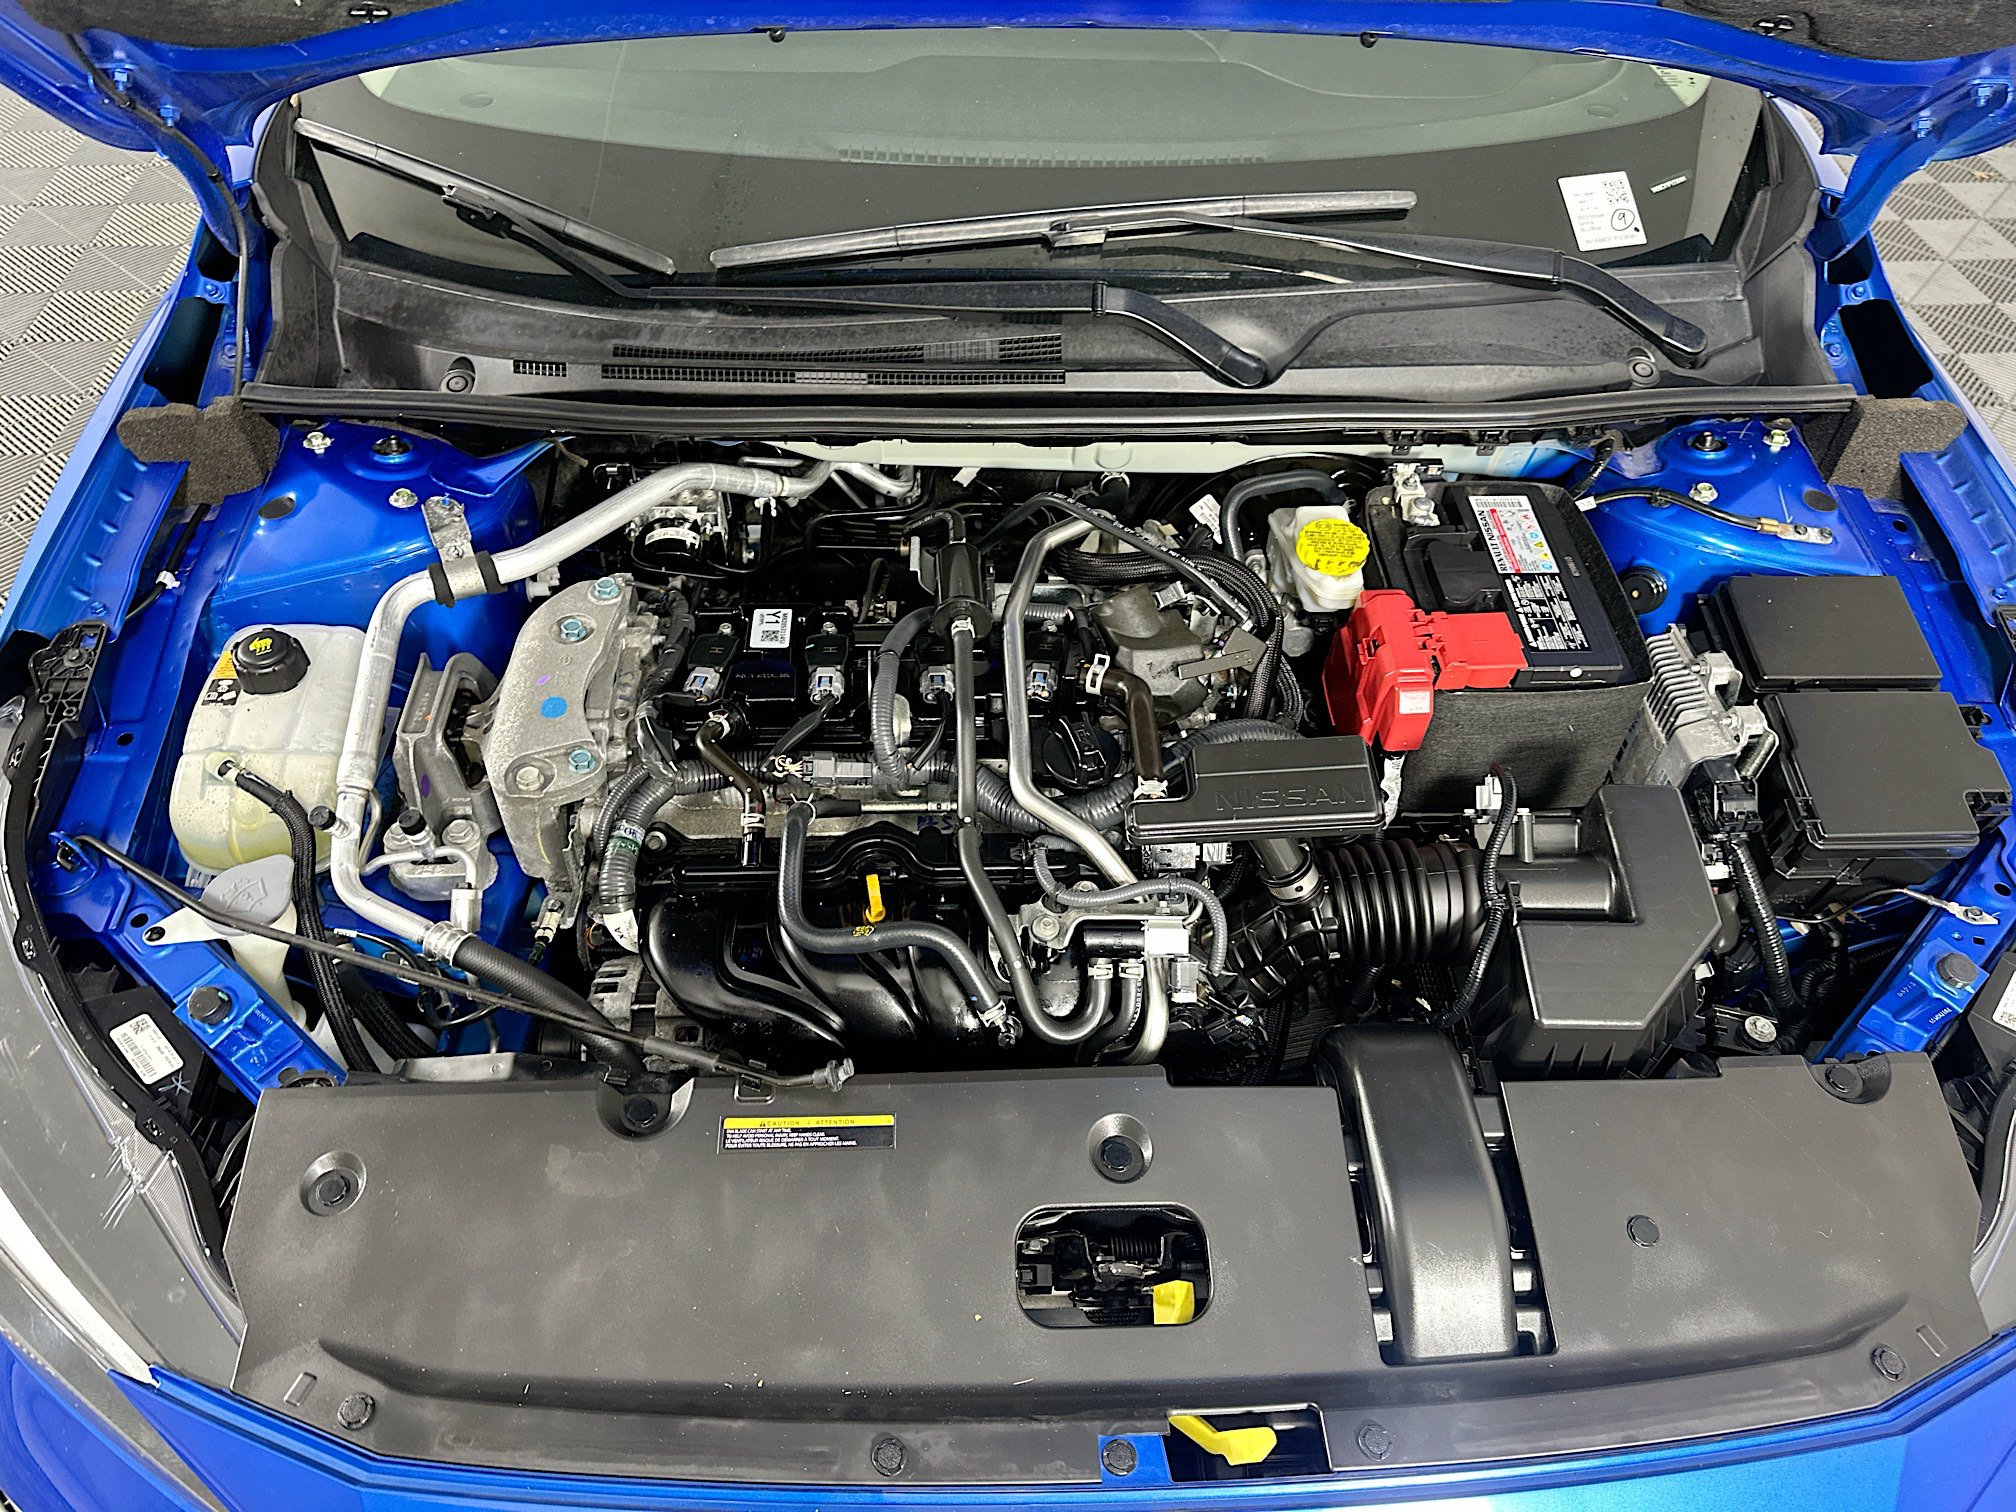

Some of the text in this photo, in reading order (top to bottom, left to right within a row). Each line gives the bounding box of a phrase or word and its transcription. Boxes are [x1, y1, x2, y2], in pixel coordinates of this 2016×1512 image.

[1477, 510, 1496, 541] NISSAN
[765, 611, 782, 624] Y1
[1214, 782, 1367, 812] NISSAN
